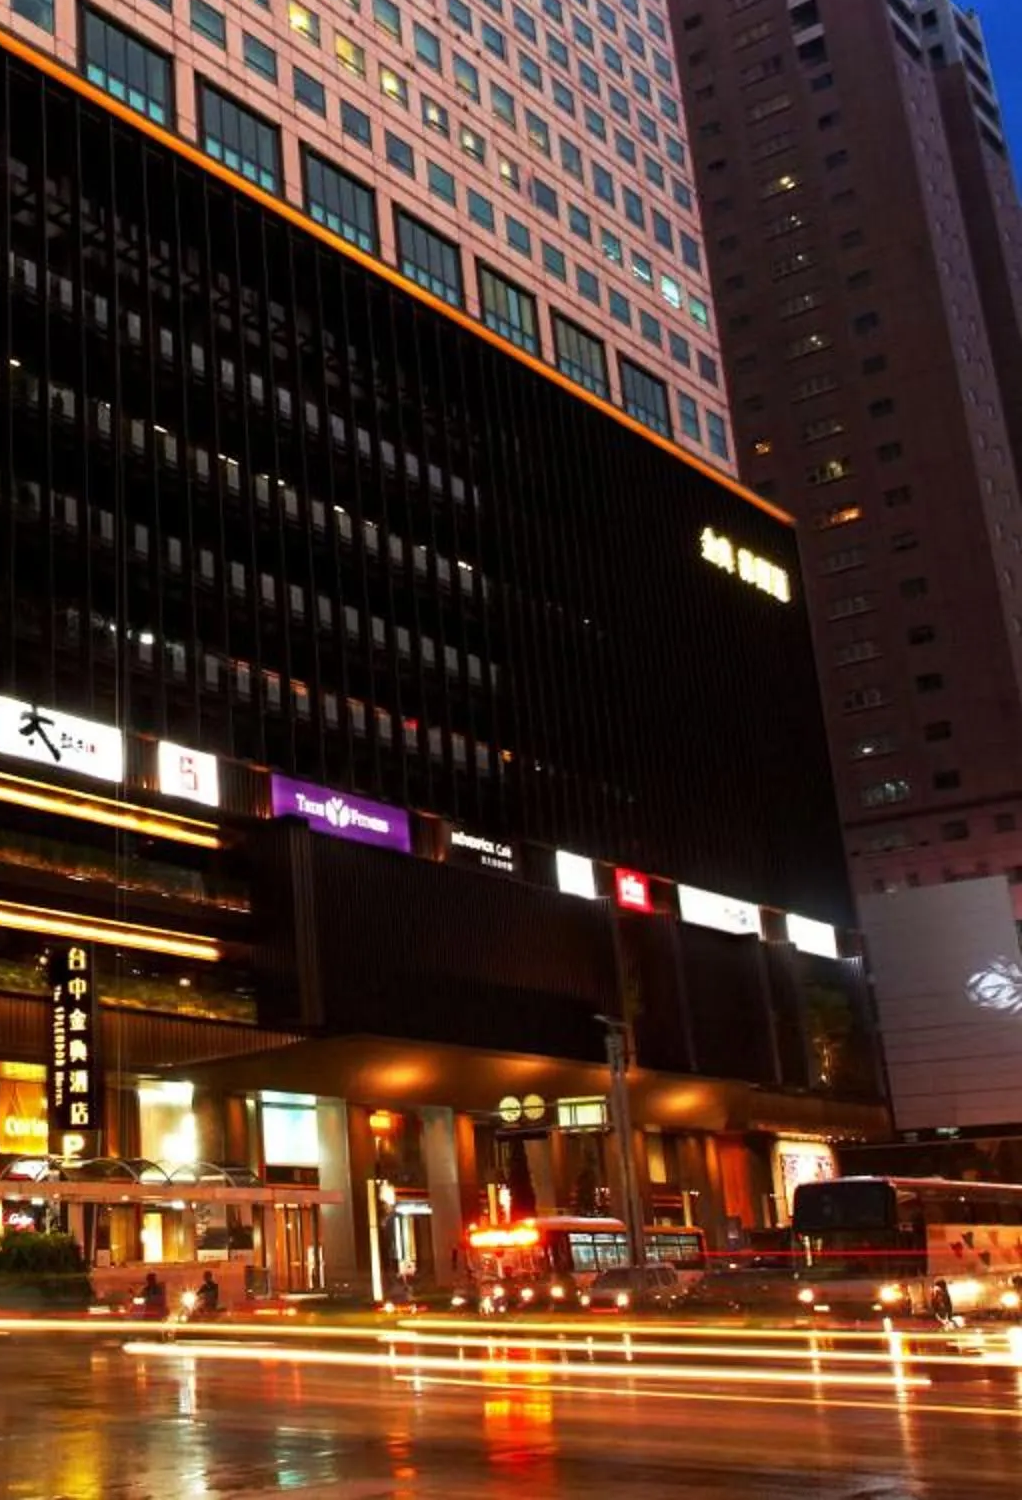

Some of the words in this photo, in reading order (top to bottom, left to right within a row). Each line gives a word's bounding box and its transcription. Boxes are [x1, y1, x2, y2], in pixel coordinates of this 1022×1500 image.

[68, 946, 89, 1126] 台中金典酒店
